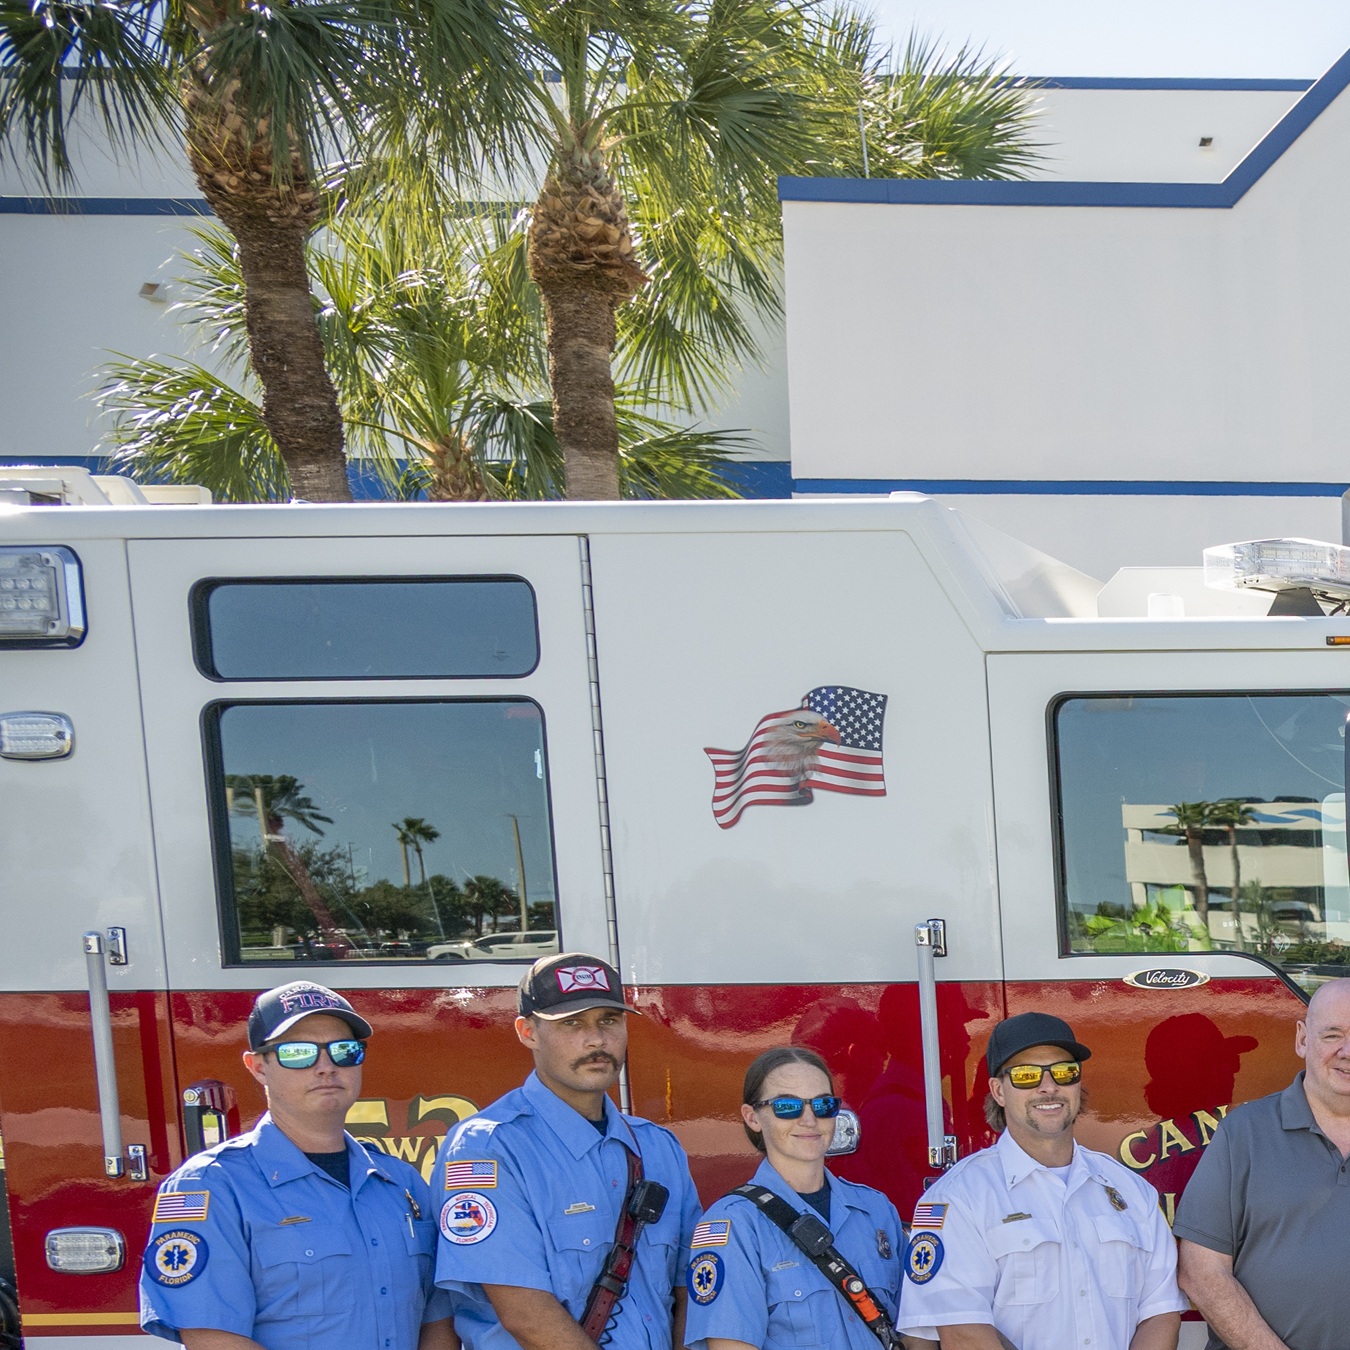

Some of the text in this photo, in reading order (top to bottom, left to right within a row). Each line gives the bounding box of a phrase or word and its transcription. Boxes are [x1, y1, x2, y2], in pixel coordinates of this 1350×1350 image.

[1145, 971, 1190, 986] Velocity
[155, 1231, 200, 1246] PARAMEDIC
[159, 1272, 193, 1284] FLORIDA
